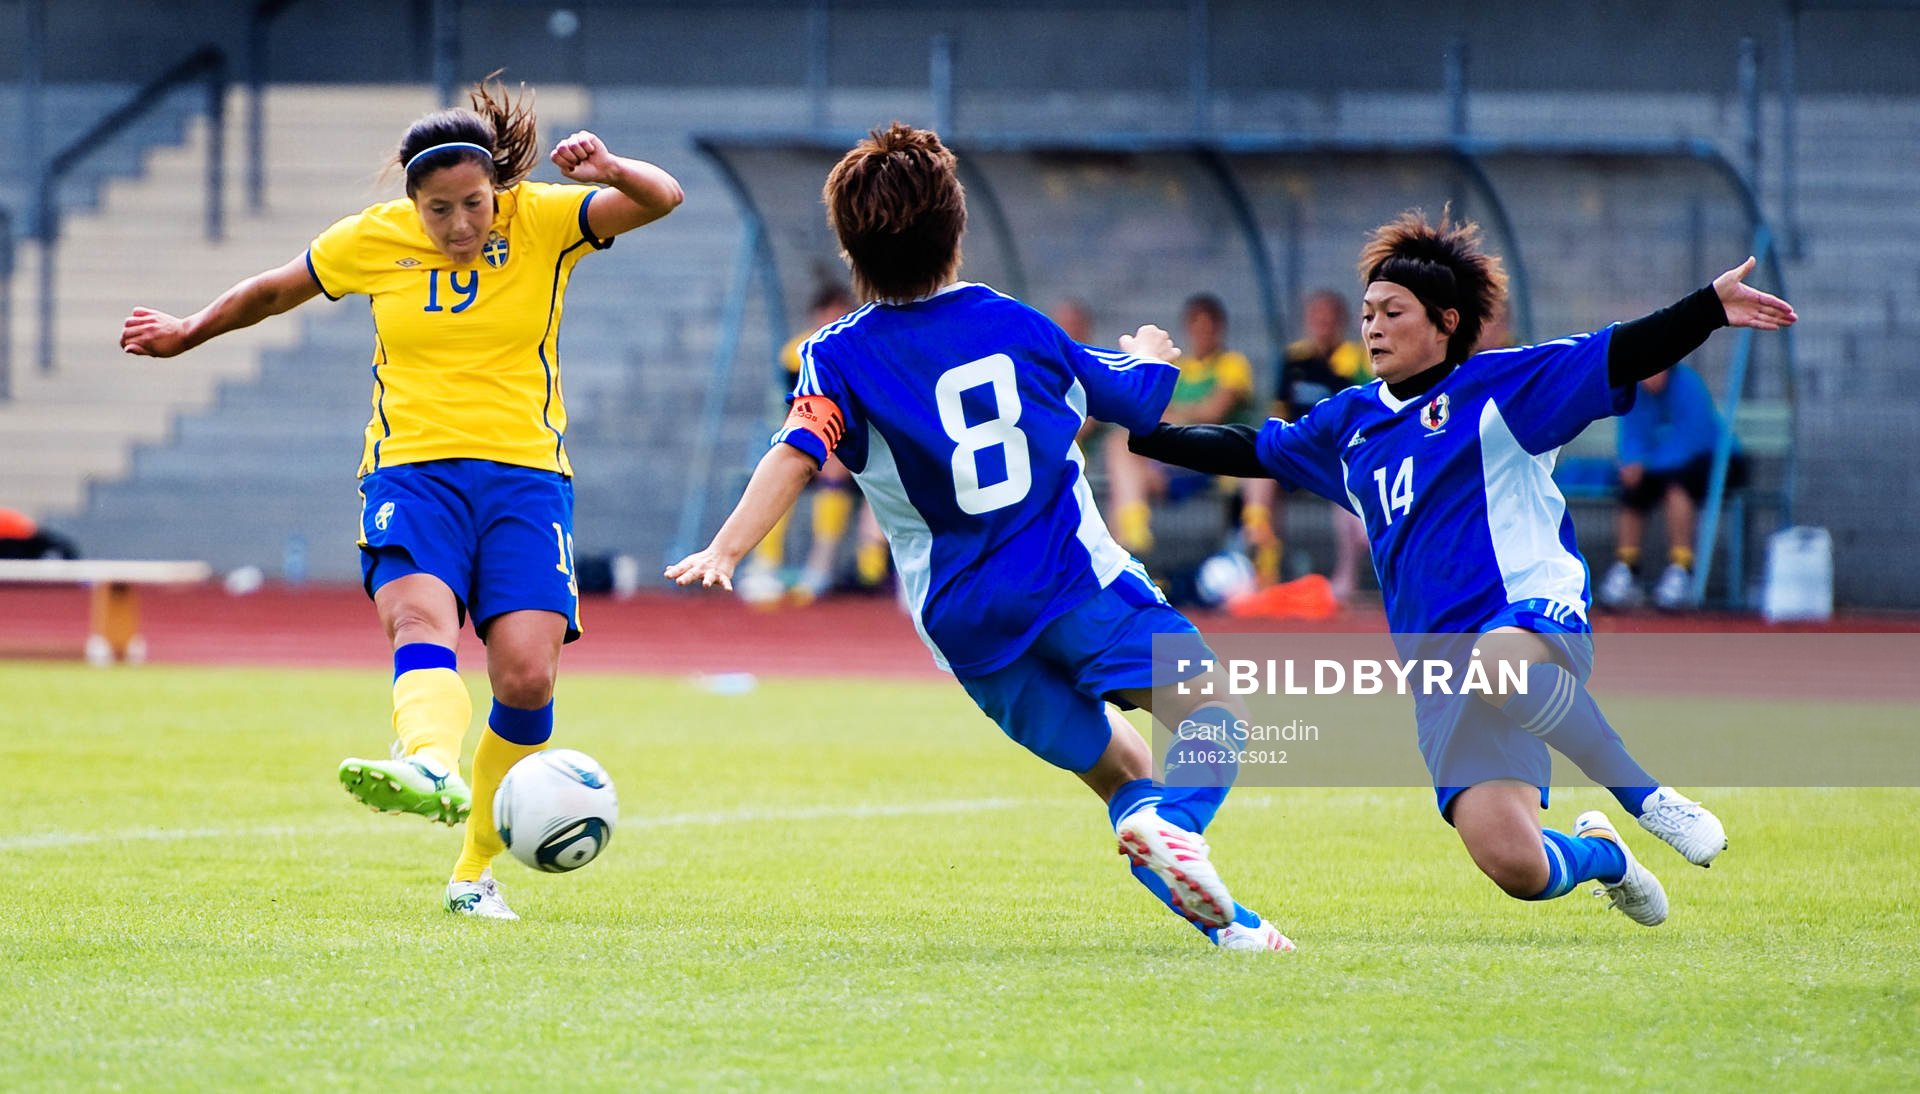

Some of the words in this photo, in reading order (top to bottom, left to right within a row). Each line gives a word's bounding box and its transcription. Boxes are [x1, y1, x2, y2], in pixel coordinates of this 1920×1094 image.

[423, 269, 479, 313] 19
[934, 352, 1033, 516] 8
[1373, 455, 1415, 526] 14
